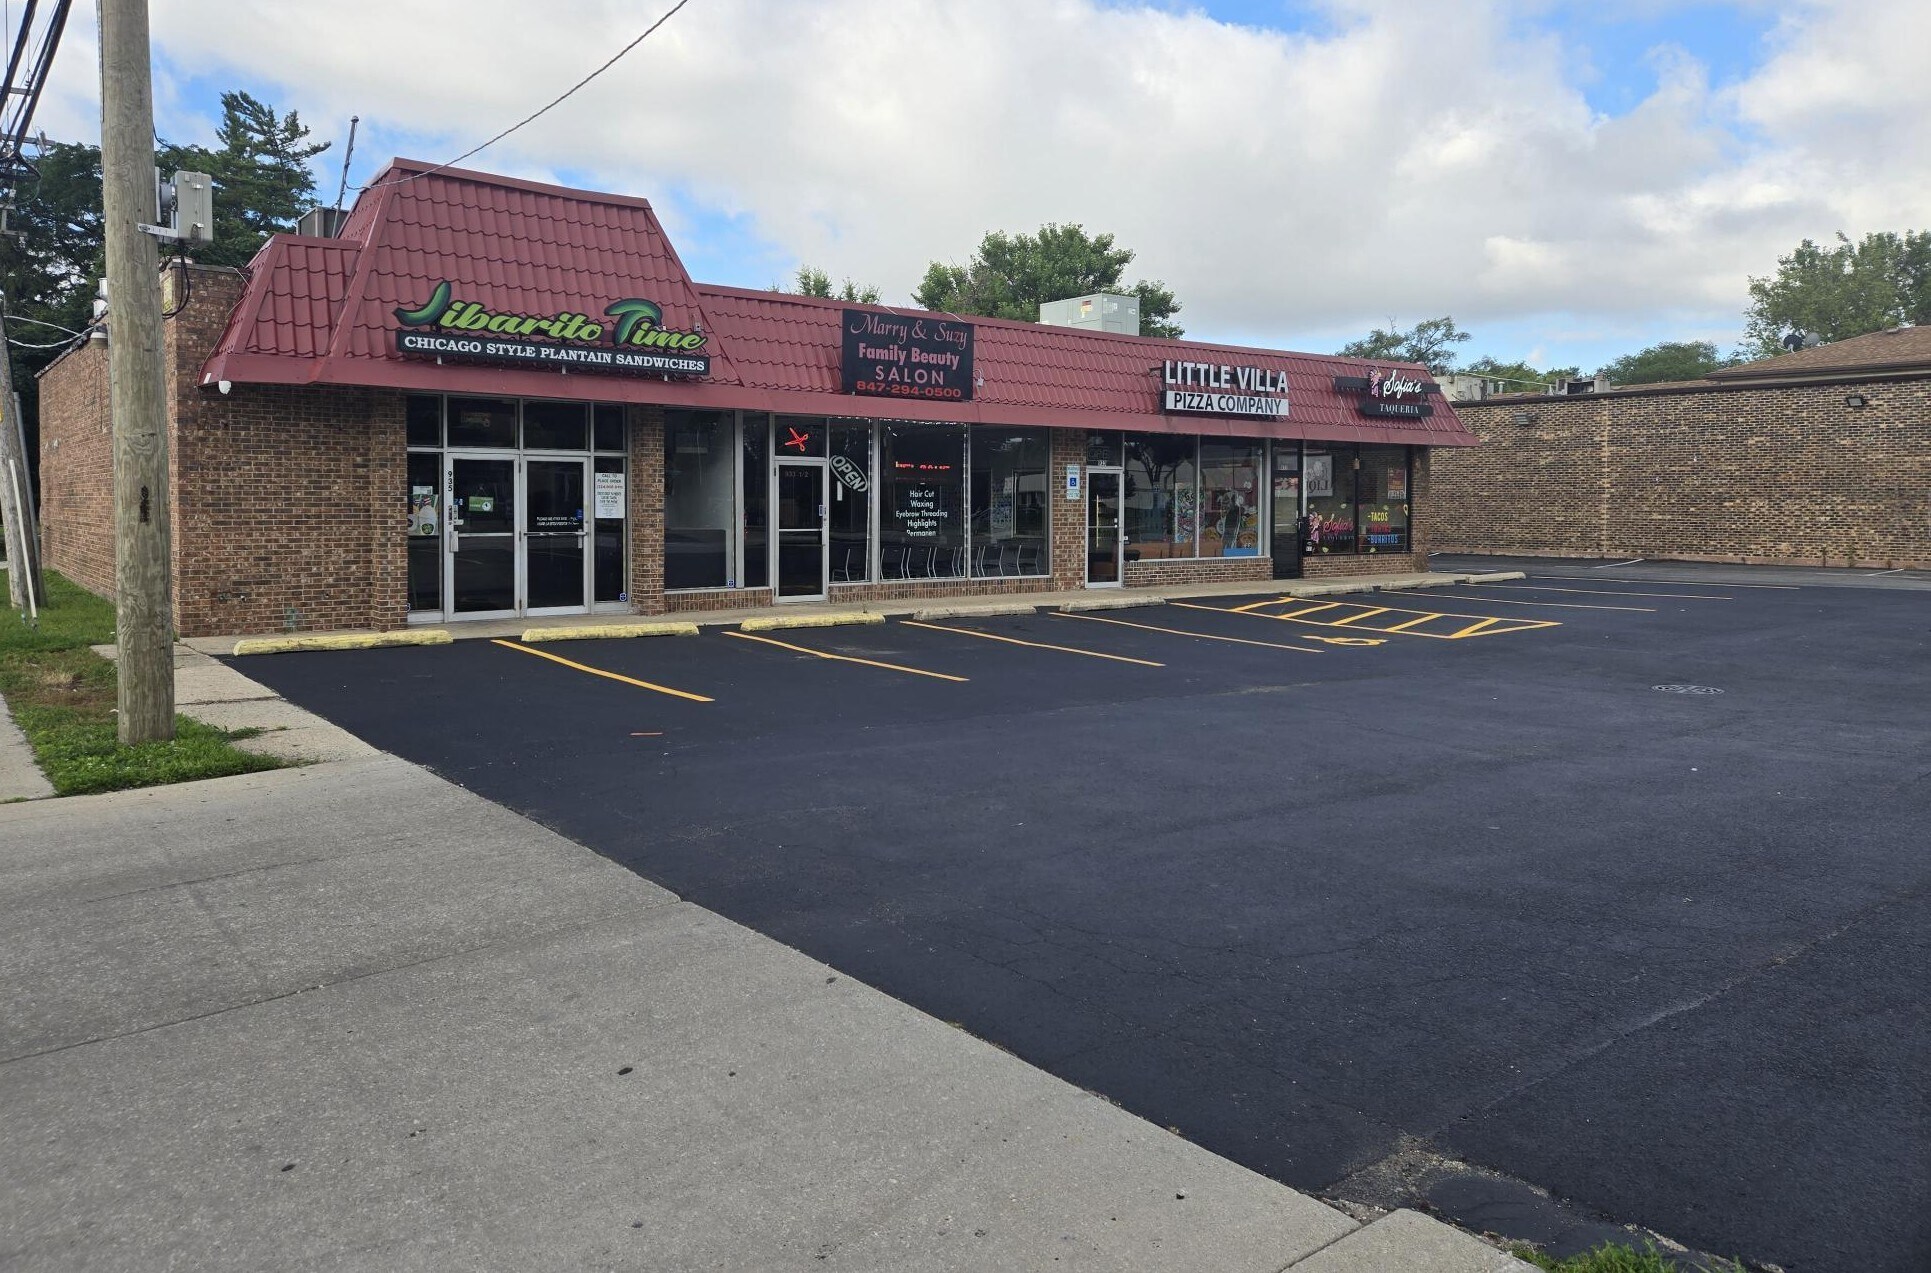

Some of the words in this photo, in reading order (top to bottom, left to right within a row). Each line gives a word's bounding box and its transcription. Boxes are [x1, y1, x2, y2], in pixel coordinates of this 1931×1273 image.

[392, 280, 604, 341] Jibarito
[605, 297, 708, 350] Time
[850, 314, 908, 345] Marry
[911, 320, 927, 339] &
[934, 322, 968, 350] Suzy
[405, 335, 482, 353] CHICAGO
[486, 343, 537, 358] STYLE
[540, 347, 612, 364] PLANTAIN
[615, 354, 705, 371] SANDWICHES
[858, 342, 906, 366] Family
[911, 347, 960, 370] Beauty
[875, 365, 944, 385] SALON
[1164, 360, 1231, 389] LITTLE
[1236, 366, 1289, 393] VILLA
[1383, 369, 1422, 399] Sofia's
[856, 380, 961, 398] 847-294-0500
[1173, 392, 1214, 411] PIZZA
[1218, 395, 1282, 415] COMPANY
[1380, 403, 1419, 414] TAQUERIA
[832, 455, 866, 490] OPEN
[909, 489, 923, 497] Hair
[910, 499, 934, 509] Waxing
[896, 509, 919, 519] Eyebrow
[921, 509, 948, 518] Threading
[907, 518, 937, 529] Highlights
